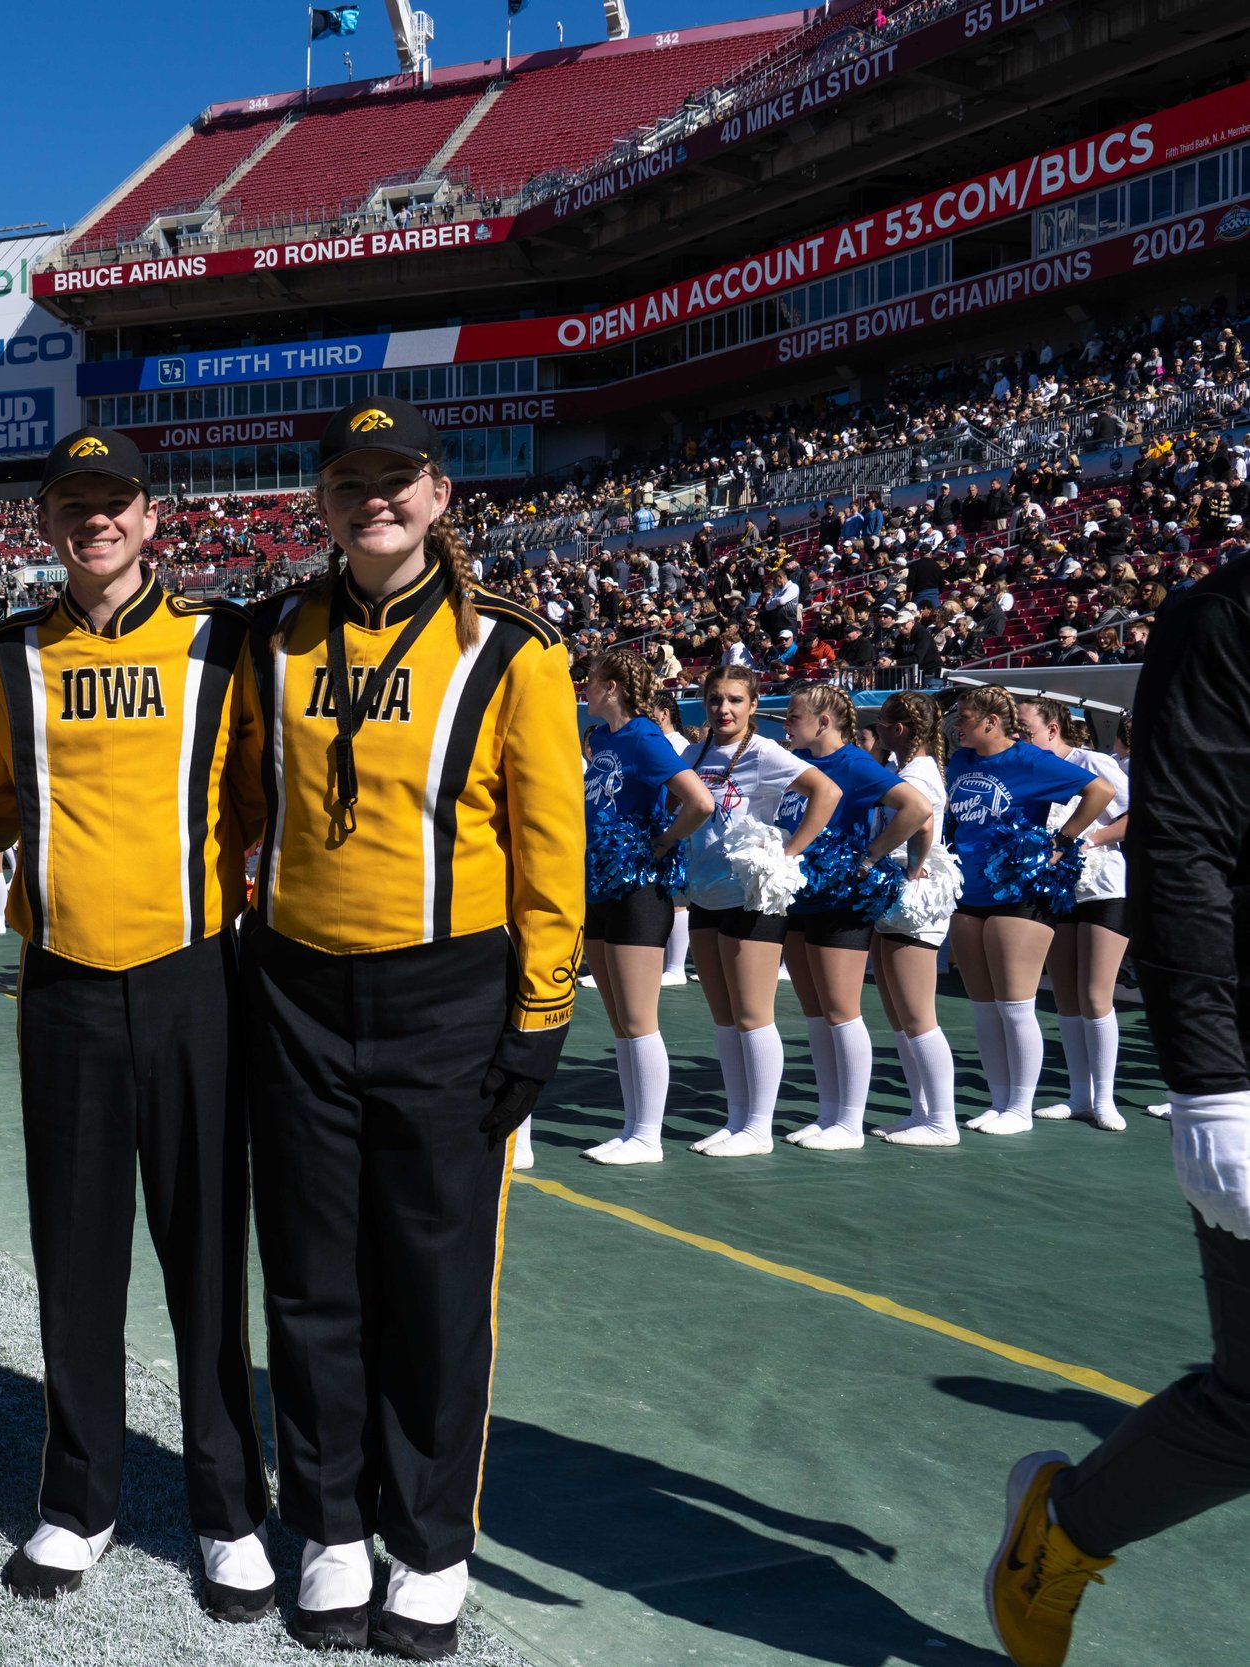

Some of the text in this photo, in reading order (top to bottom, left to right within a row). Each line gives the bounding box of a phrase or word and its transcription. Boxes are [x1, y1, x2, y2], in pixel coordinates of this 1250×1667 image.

[964, 2, 993, 38] 55
[655, 32, 679, 46] 342
[248, 97, 269, 110] 344
[720, 44, 899, 144] 40 MIKE ALSTOTT
[1165, 147, 1179, 159] Fifth
[1179, 141, 1195, 154] Third
[553, 146, 673, 218] 47 JOHN LYNCH
[253, 224, 470, 269] 20 RONDÉ BARBER
[557, 122, 1155, 347] OPEN AN ACCOUNT AT 53.COM/BUCS
[54, 256, 207, 292] BRUCE ARIANS
[778, 322, 848, 363] SUPER
[855, 301, 925, 342] BOWL
[930, 250, 1092, 321] CHAMPIONS
[1132, 217, 1205, 266] 2002
[197, 352, 270, 378] FIFTH
[281, 344, 363, 370] THIRD
[502, 399, 555, 421] RICE
[159, 420, 294, 448] JON GRUDEN
[46, 570, 68, 581] RIP
[60, 665, 167, 722] IOWA
[950, 794, 983, 814] ame
[959, 807, 989, 825] day
